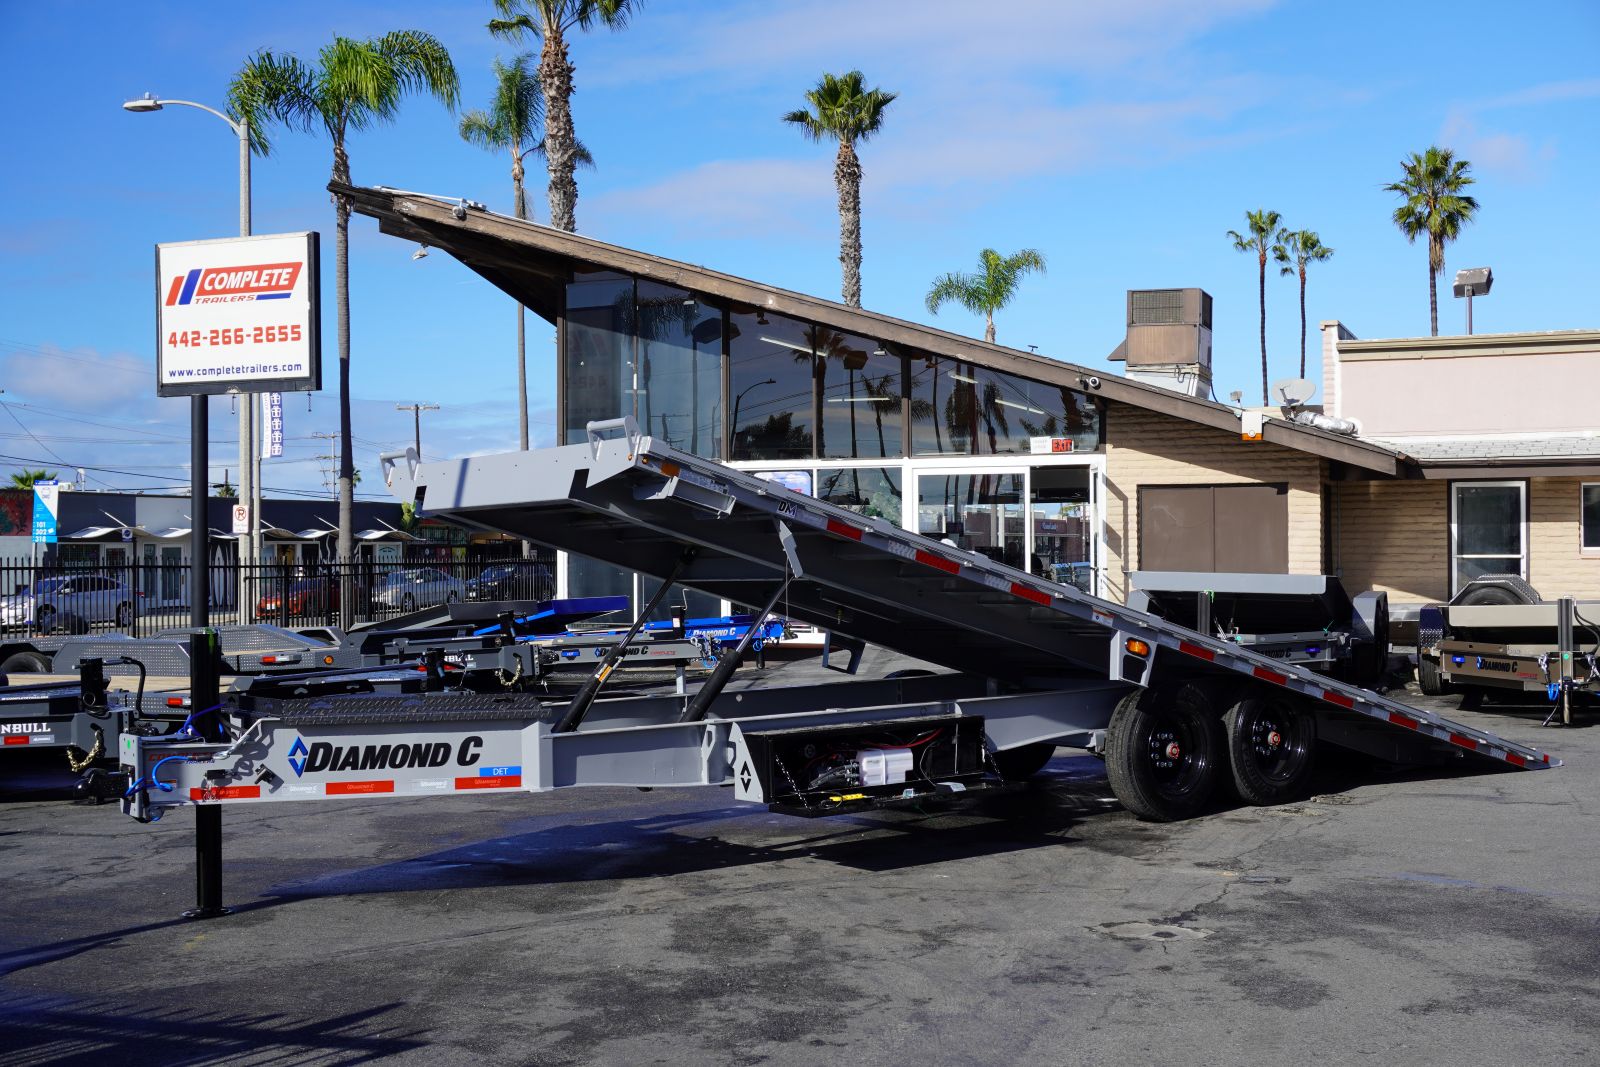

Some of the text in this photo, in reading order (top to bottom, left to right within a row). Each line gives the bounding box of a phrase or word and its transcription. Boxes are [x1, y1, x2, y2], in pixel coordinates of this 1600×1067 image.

[203, 267, 293, 291] COMPLETE
[195, 294, 256, 304] TRAILERS
[168, 324, 302, 348] 442-266-2655
[168, 363, 302, 377] www.completetrailers.com
[1052, 438, 1073, 452] EXIT
[1480, 658, 1518, 673] DIAMOND C
[304, 735, 484, 772] DIAMOND C
[492, 767, 509, 776] DET
